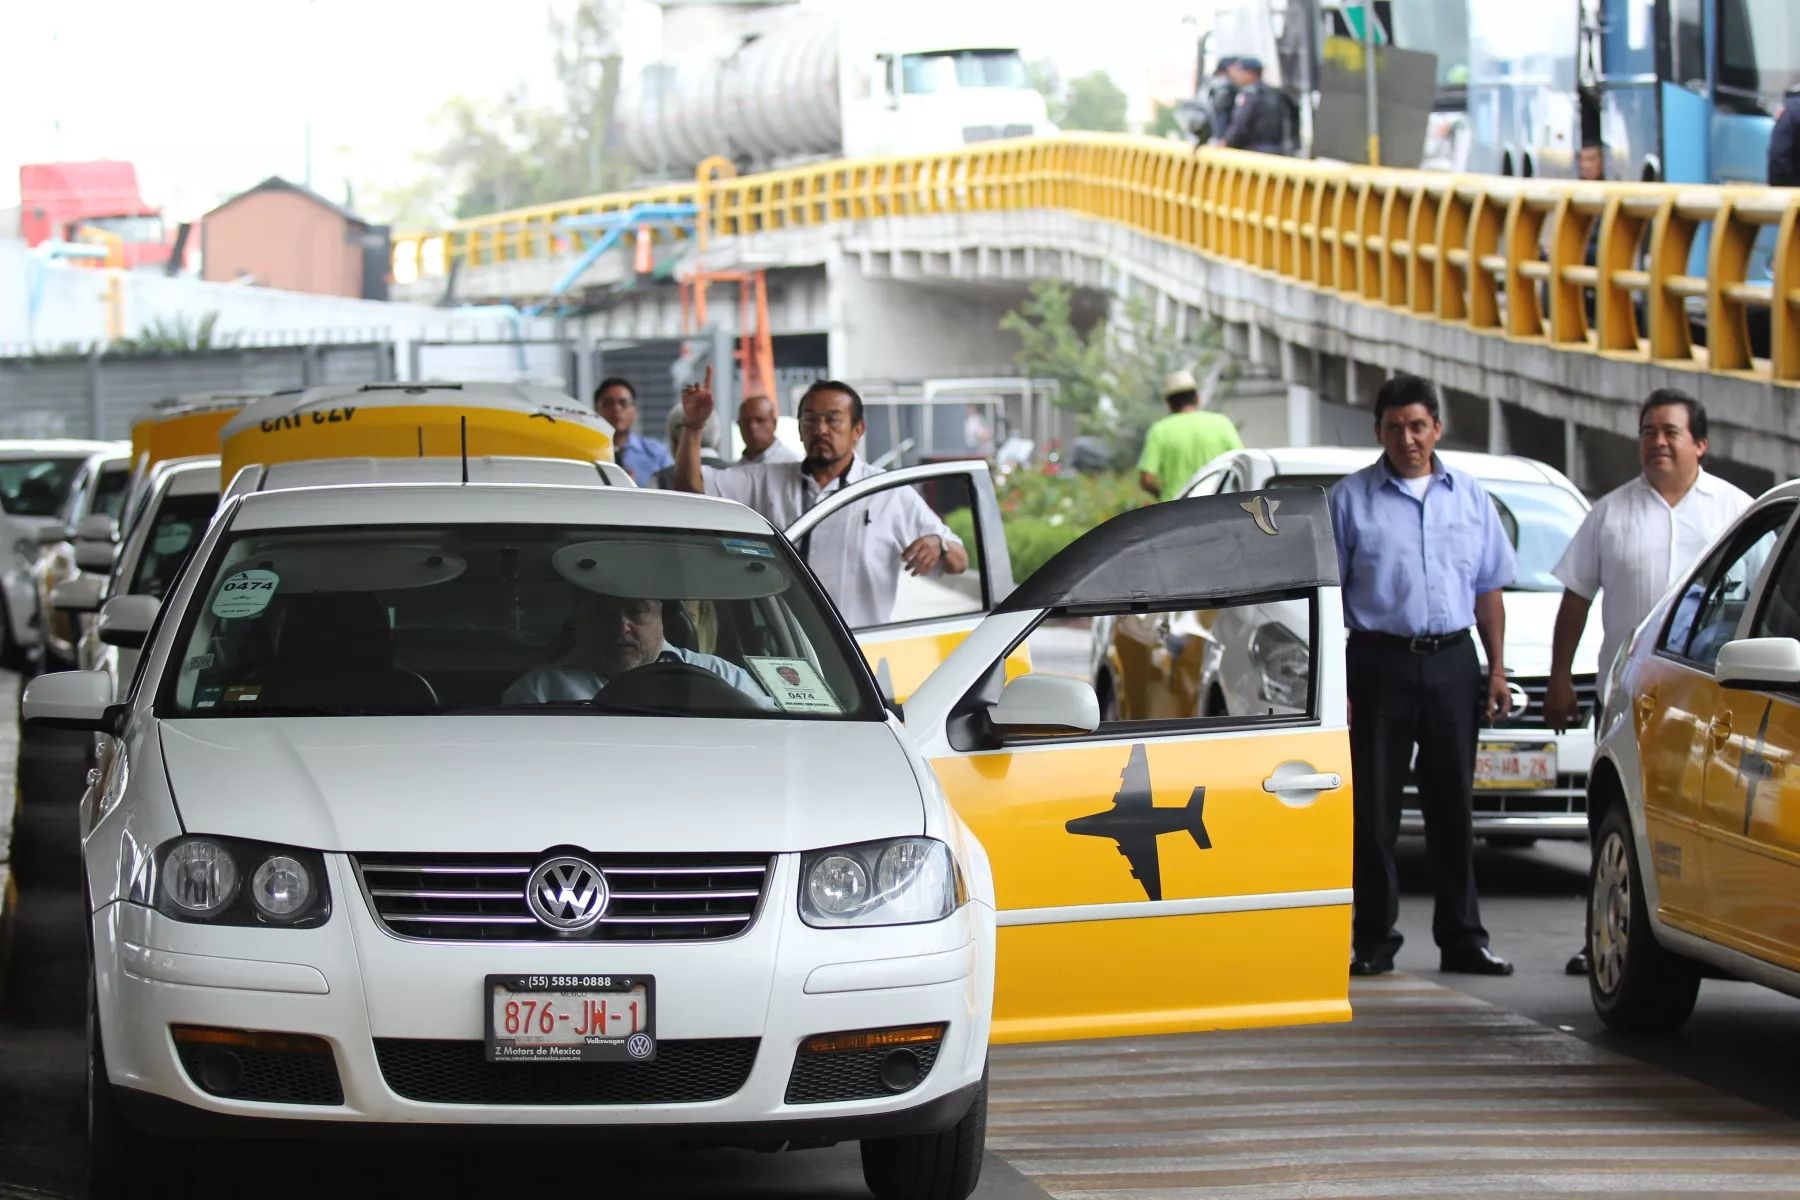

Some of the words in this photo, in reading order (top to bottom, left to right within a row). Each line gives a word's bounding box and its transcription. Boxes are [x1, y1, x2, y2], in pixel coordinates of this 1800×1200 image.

[224, 582, 273, 592] 0474
[527, 856, 609, 931] VW
[528, 976, 549, 988] (55)
[551, 976, 612, 987] 5858-0888
[505, 1000, 640, 1035] 876-JW-1
[586, 1037, 625, 1045] Volkswagen
[495, 1047, 502, 1055] Z
[503, 1047, 534, 1055] Motors
[536, 1046, 549, 1055] de
[549, 1047, 581, 1055] Mexico
